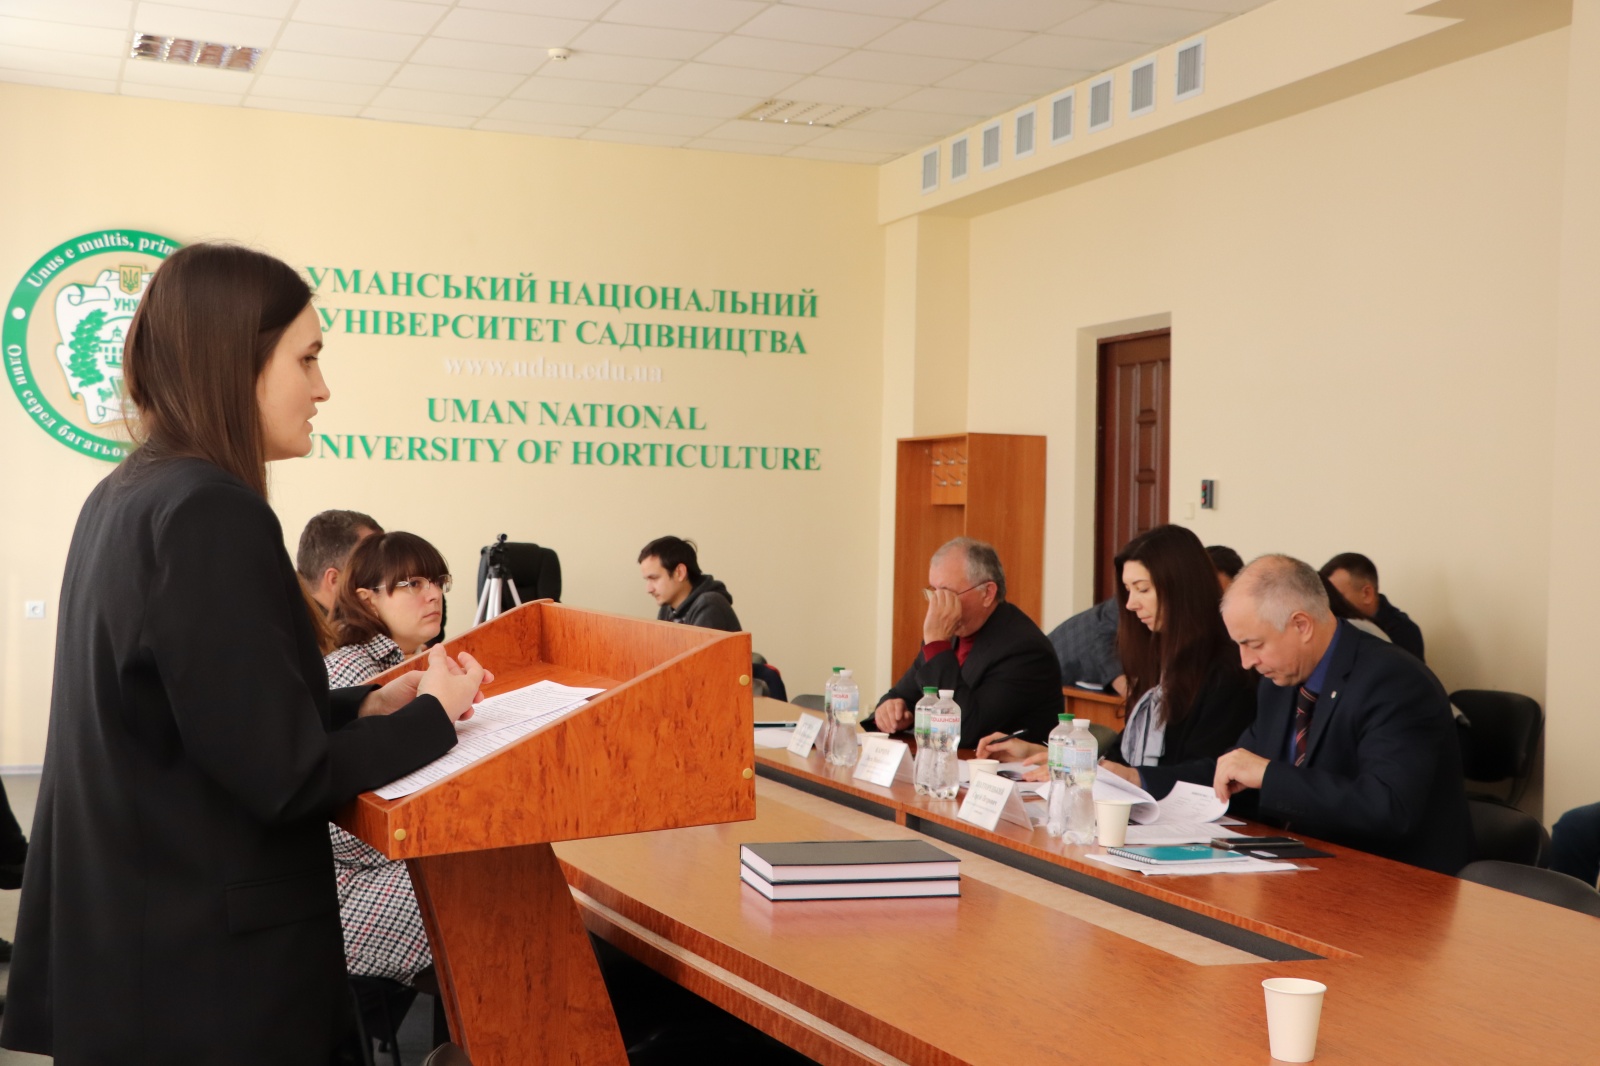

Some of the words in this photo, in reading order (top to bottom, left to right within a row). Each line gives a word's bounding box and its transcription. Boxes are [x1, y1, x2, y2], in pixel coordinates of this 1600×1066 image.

[26, 255, 65, 288] Unus
[65, 248, 76, 259] e
[77, 231, 135, 254] multis,
[138, 237, 179, 255] prim
[113, 297, 142, 312] УНУ
[304, 265, 538, 307] УМАНСЬКИЙ
[548, 279, 820, 319] НАЦІОНАЛЬНИЙ
[316, 306, 568, 345] УНІВЕРСИТЕТ
[574, 319, 808, 357] САДІВНИЦТВА
[7, 344, 28, 386] Один
[22, 390, 57, 429] серед
[444, 356, 664, 384] www.udau.edu.ua
[426, 396, 529, 426] UMAN
[538, 400, 708, 431] NATIONAL
[516, 438, 566, 466] OF
[571, 440, 822, 473] HORTICULTURE
